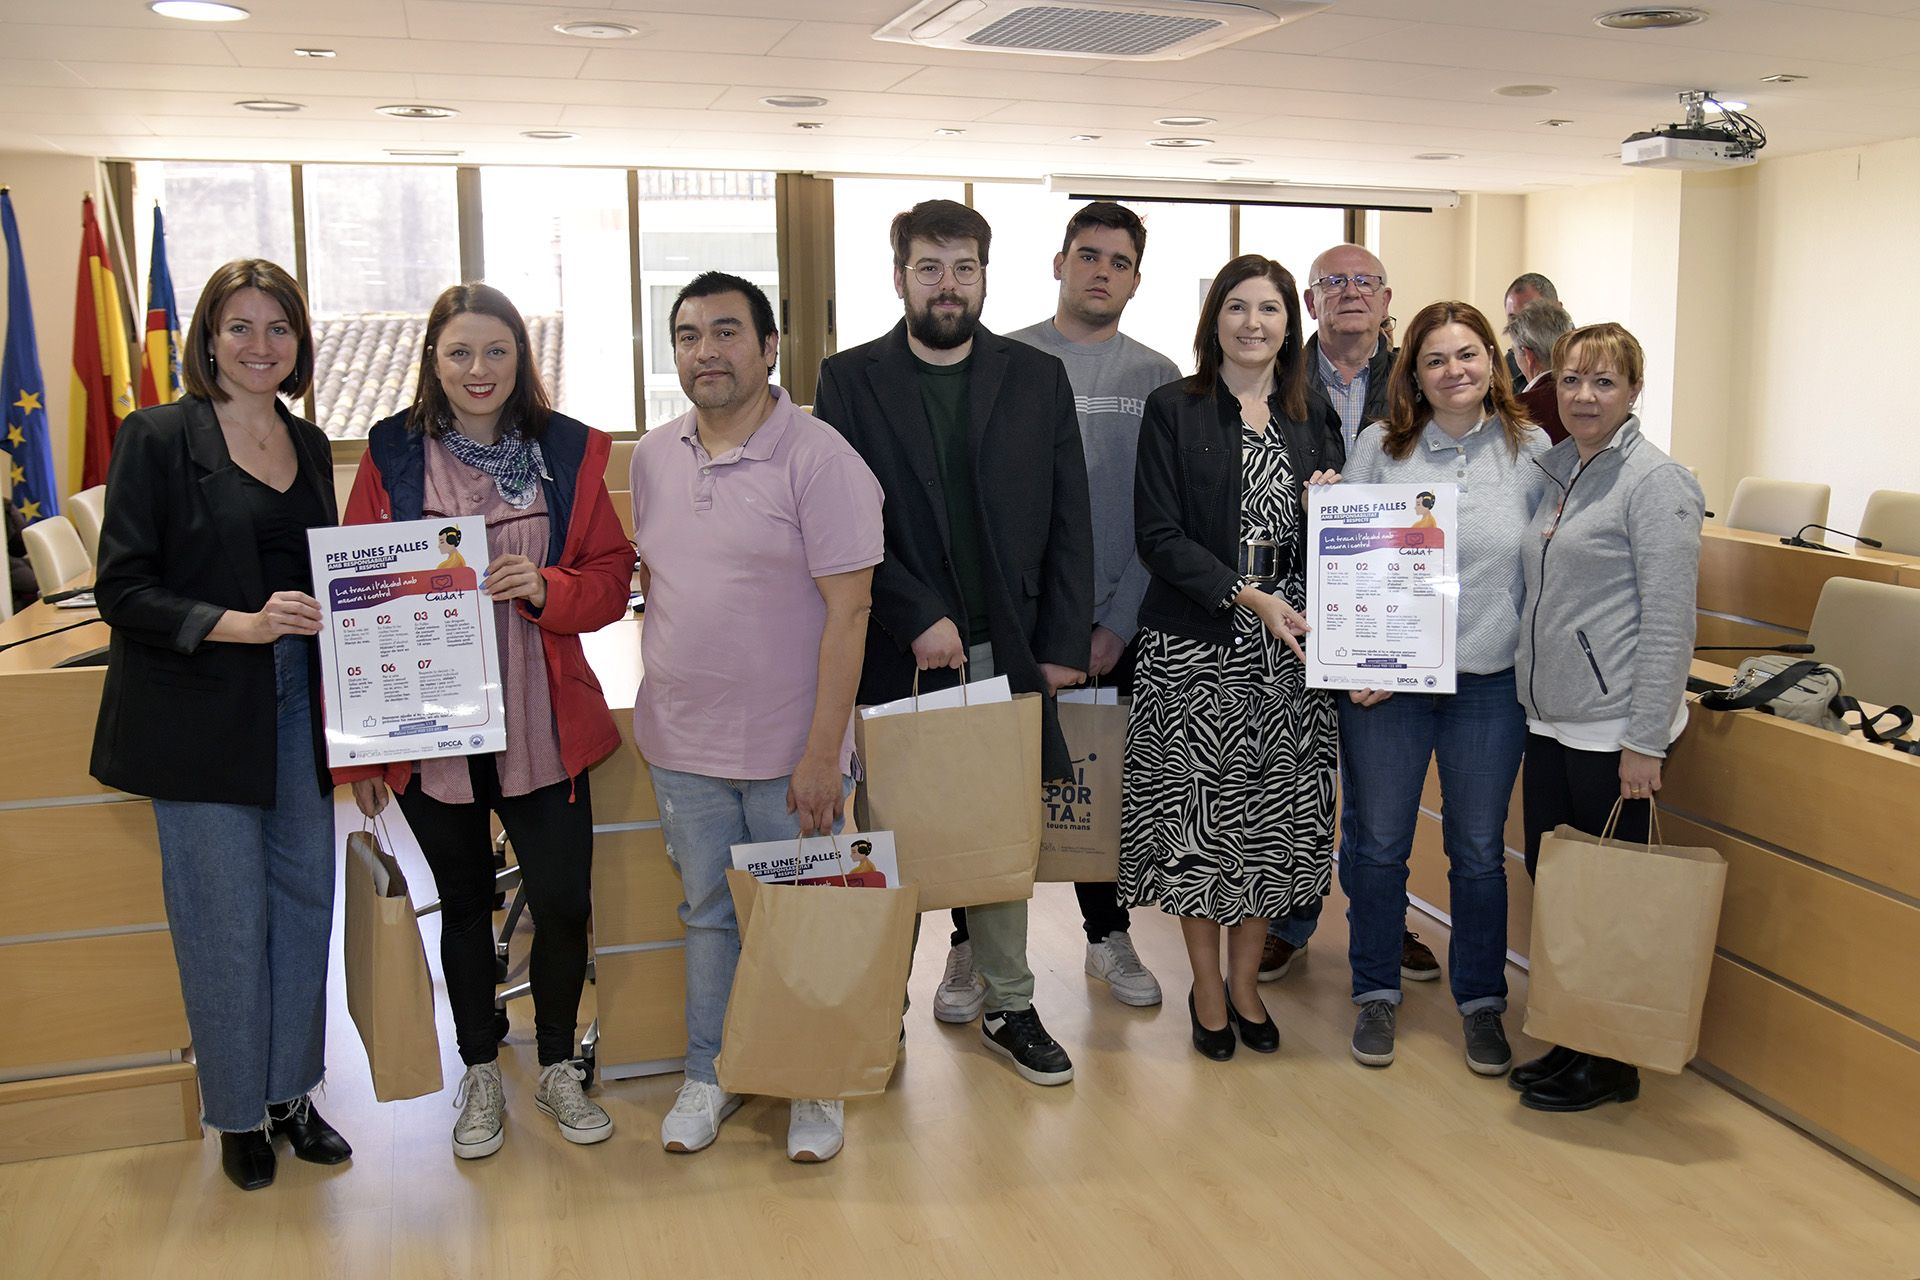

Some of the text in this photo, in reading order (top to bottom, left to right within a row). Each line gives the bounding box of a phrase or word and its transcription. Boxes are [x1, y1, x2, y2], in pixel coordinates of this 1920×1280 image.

[1342, 504, 1369, 513] UNES
[1373, 502, 1407, 511] FALLES
[326, 541, 428, 563] PER UNES FALLES
[343, 555, 395, 568] RESPONSABILITAT
[359, 563, 386, 571] RESPECTE
[1327, 562, 1338, 570] 01
[1388, 563, 1399, 571] 03
[1413, 563, 1425, 571] 04
[336, 588, 348, 597] La
[350, 585, 371, 594] traca
[403, 576, 418, 586] amb
[368, 591, 391, 600] control
[342, 609, 458, 628] 01 02 03 04
[348, 660, 432, 676] 05 06 07
[438, 739, 462, 748] UPCCA
[1047, 804, 1075, 822] TA
[748, 851, 842, 871] PER UNES FALLES
